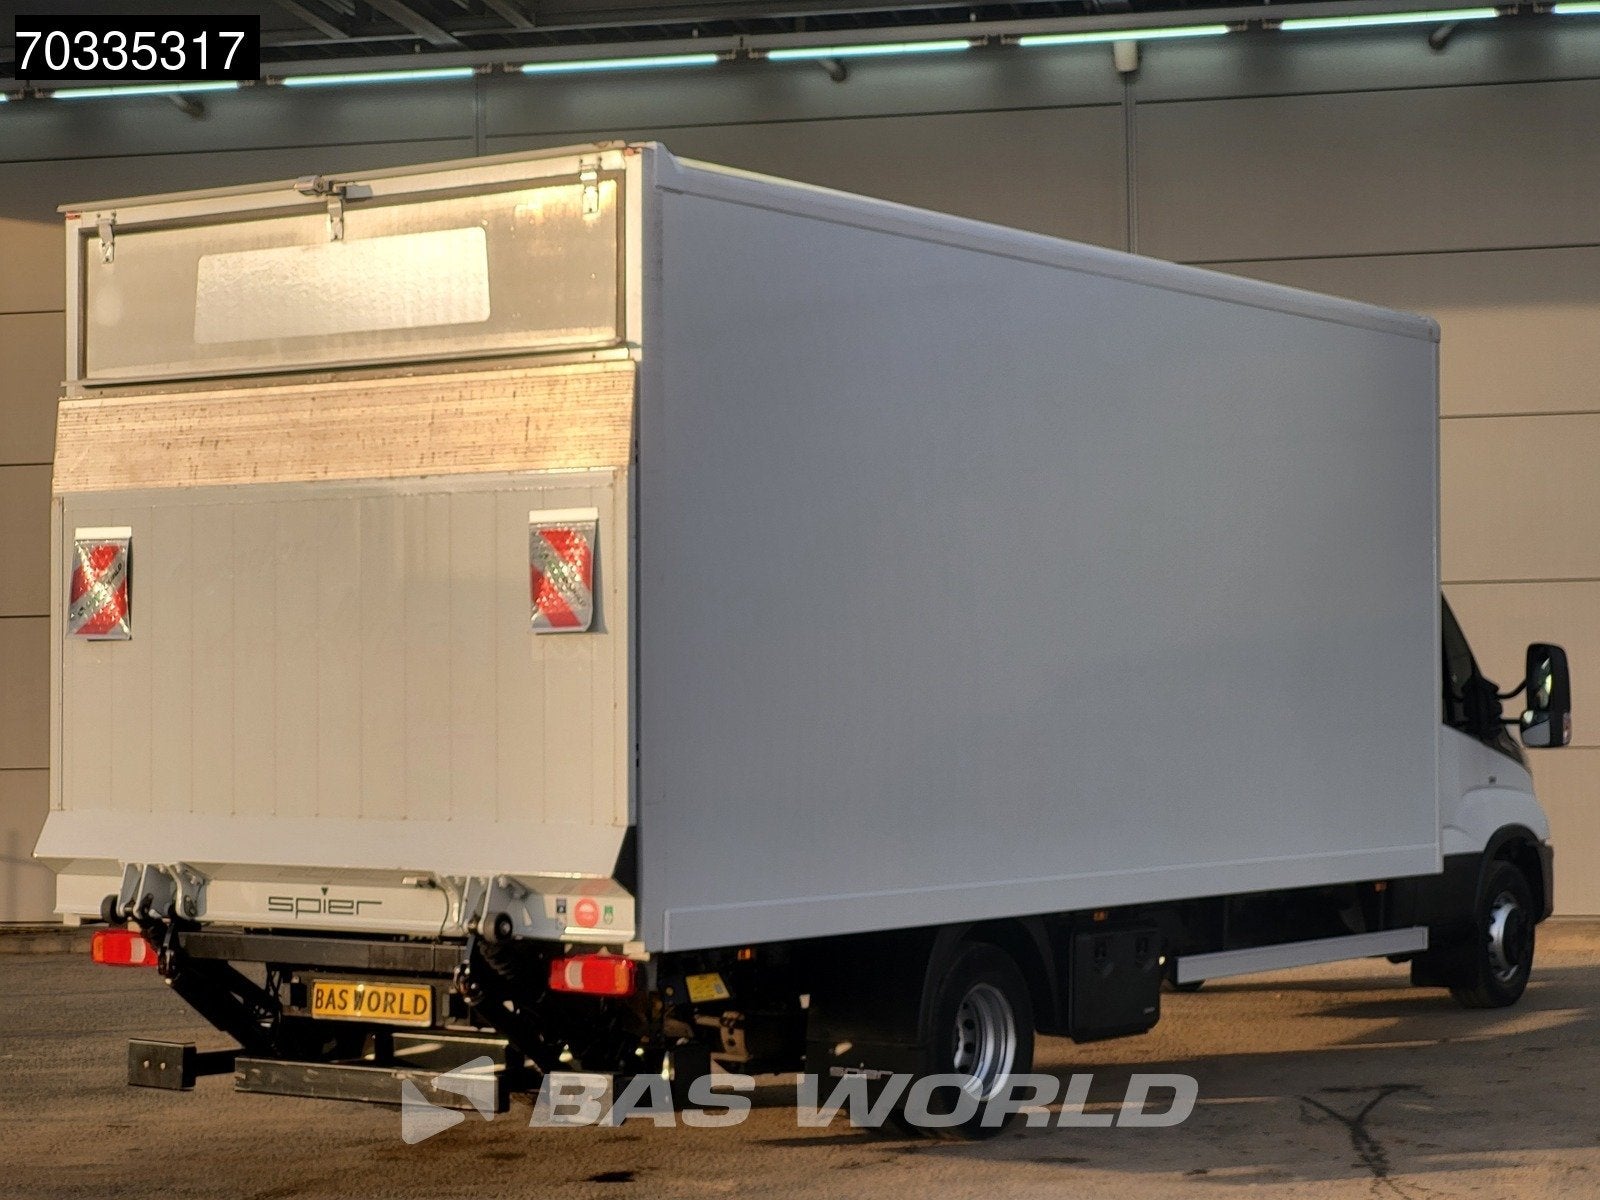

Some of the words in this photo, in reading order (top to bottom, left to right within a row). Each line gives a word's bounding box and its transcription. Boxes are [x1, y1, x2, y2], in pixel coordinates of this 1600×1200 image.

[268, 888, 382, 919] spier
[315, 988, 349, 1011] BAS
[354, 989, 428, 1016] WORLD
